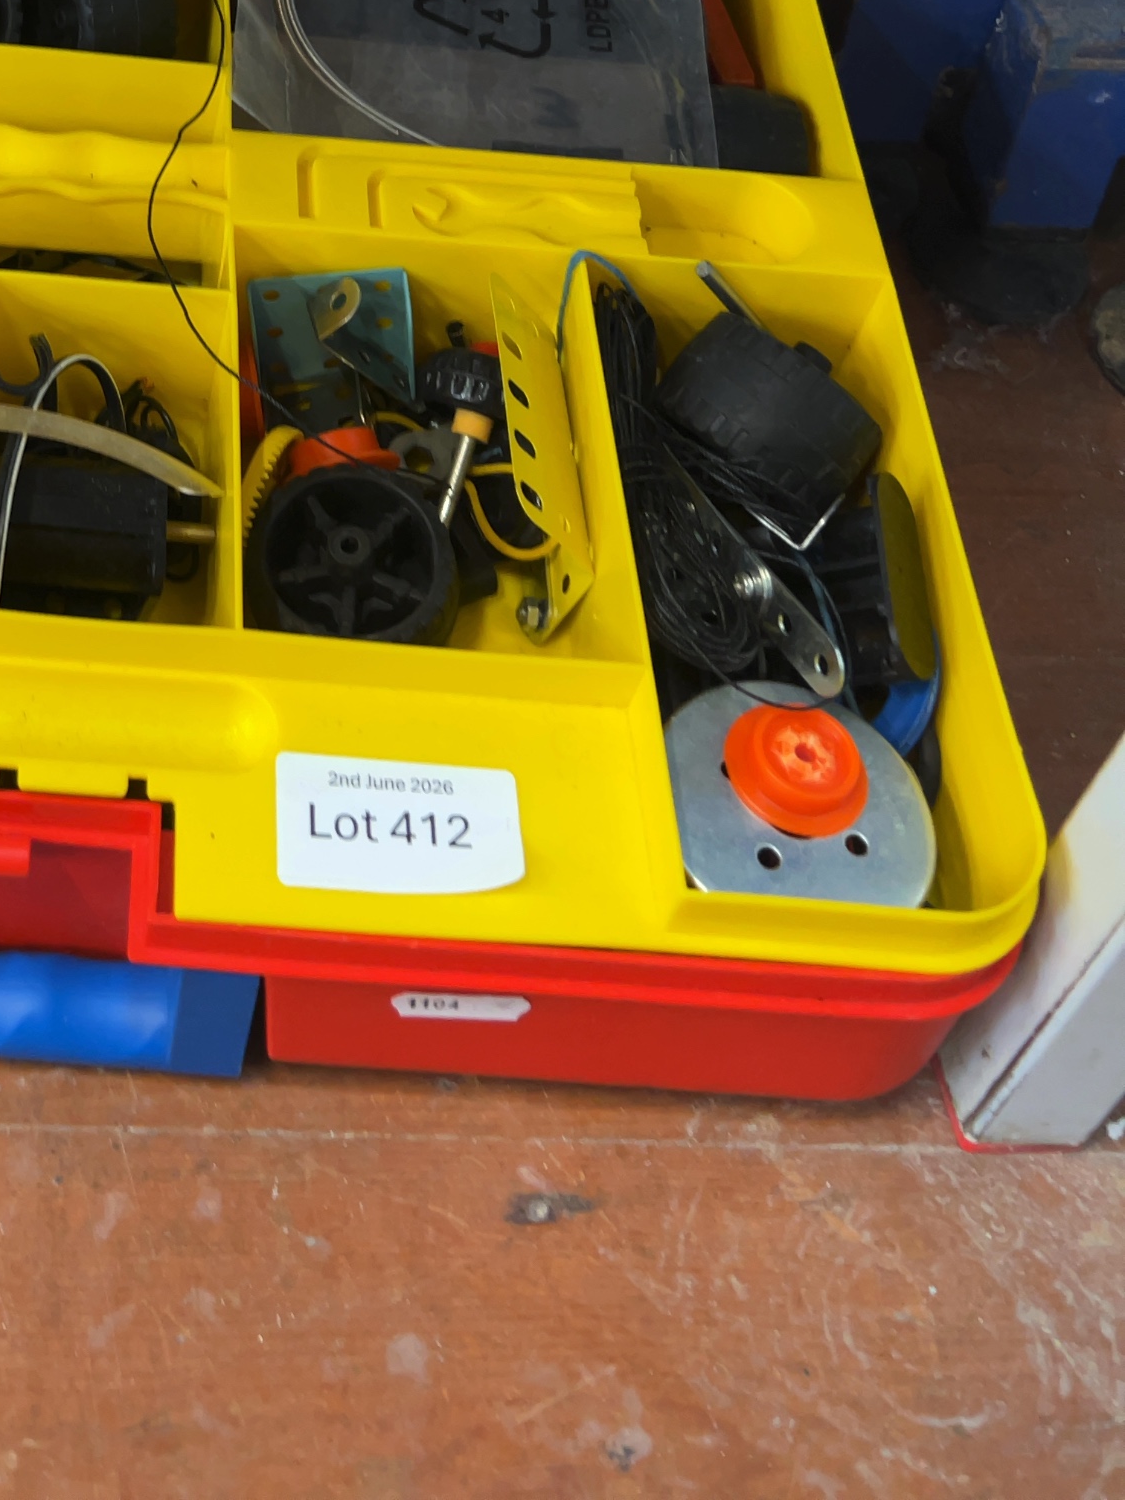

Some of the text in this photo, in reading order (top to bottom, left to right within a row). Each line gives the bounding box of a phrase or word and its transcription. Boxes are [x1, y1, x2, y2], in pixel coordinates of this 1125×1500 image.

[480, 8, 510, 25] 4
[328, 770, 454, 796] 2nd June 2026
[308, 801, 474, 851] Lot 412
